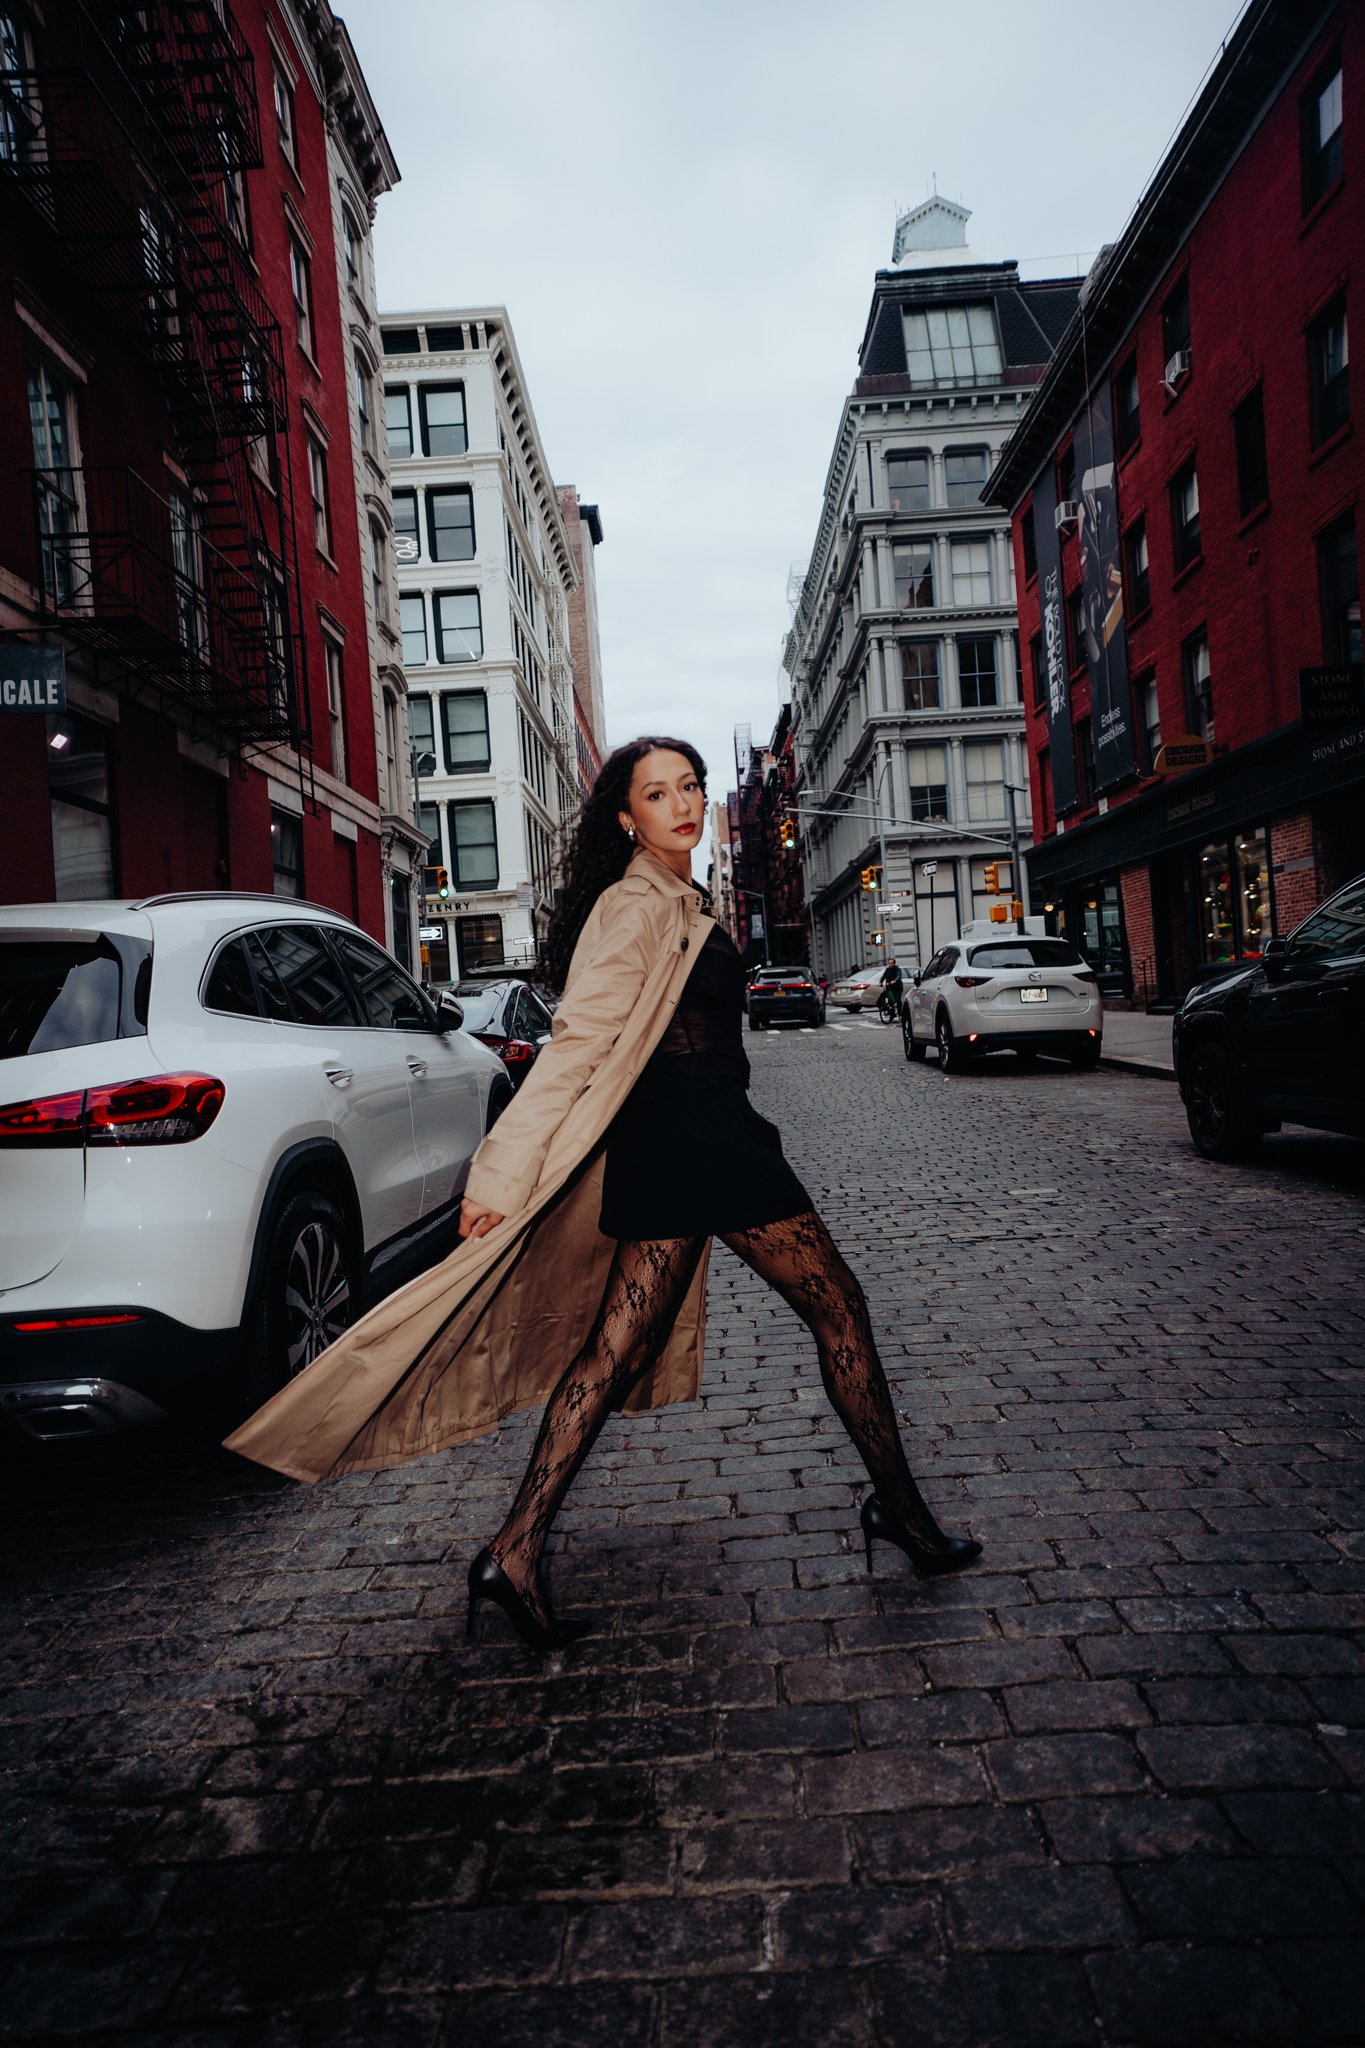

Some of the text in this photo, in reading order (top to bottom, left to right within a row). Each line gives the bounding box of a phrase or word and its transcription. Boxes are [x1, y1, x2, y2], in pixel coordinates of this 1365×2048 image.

[1051, 566, 1066, 712] THE BOLD LOOK
[1311, 672, 1352, 686] STONE
[0, 679, 58, 705] CALE
[1320, 690, 1347, 701] AND
[1310, 706, 1359, 720] STRAND
[1165, 744, 1207, 756] DINOSAUR
[1312, 743, 1336, 762] STONE
[1339, 734, 1356, 750] AND
[1166, 754, 1207, 767] DESIGNS
